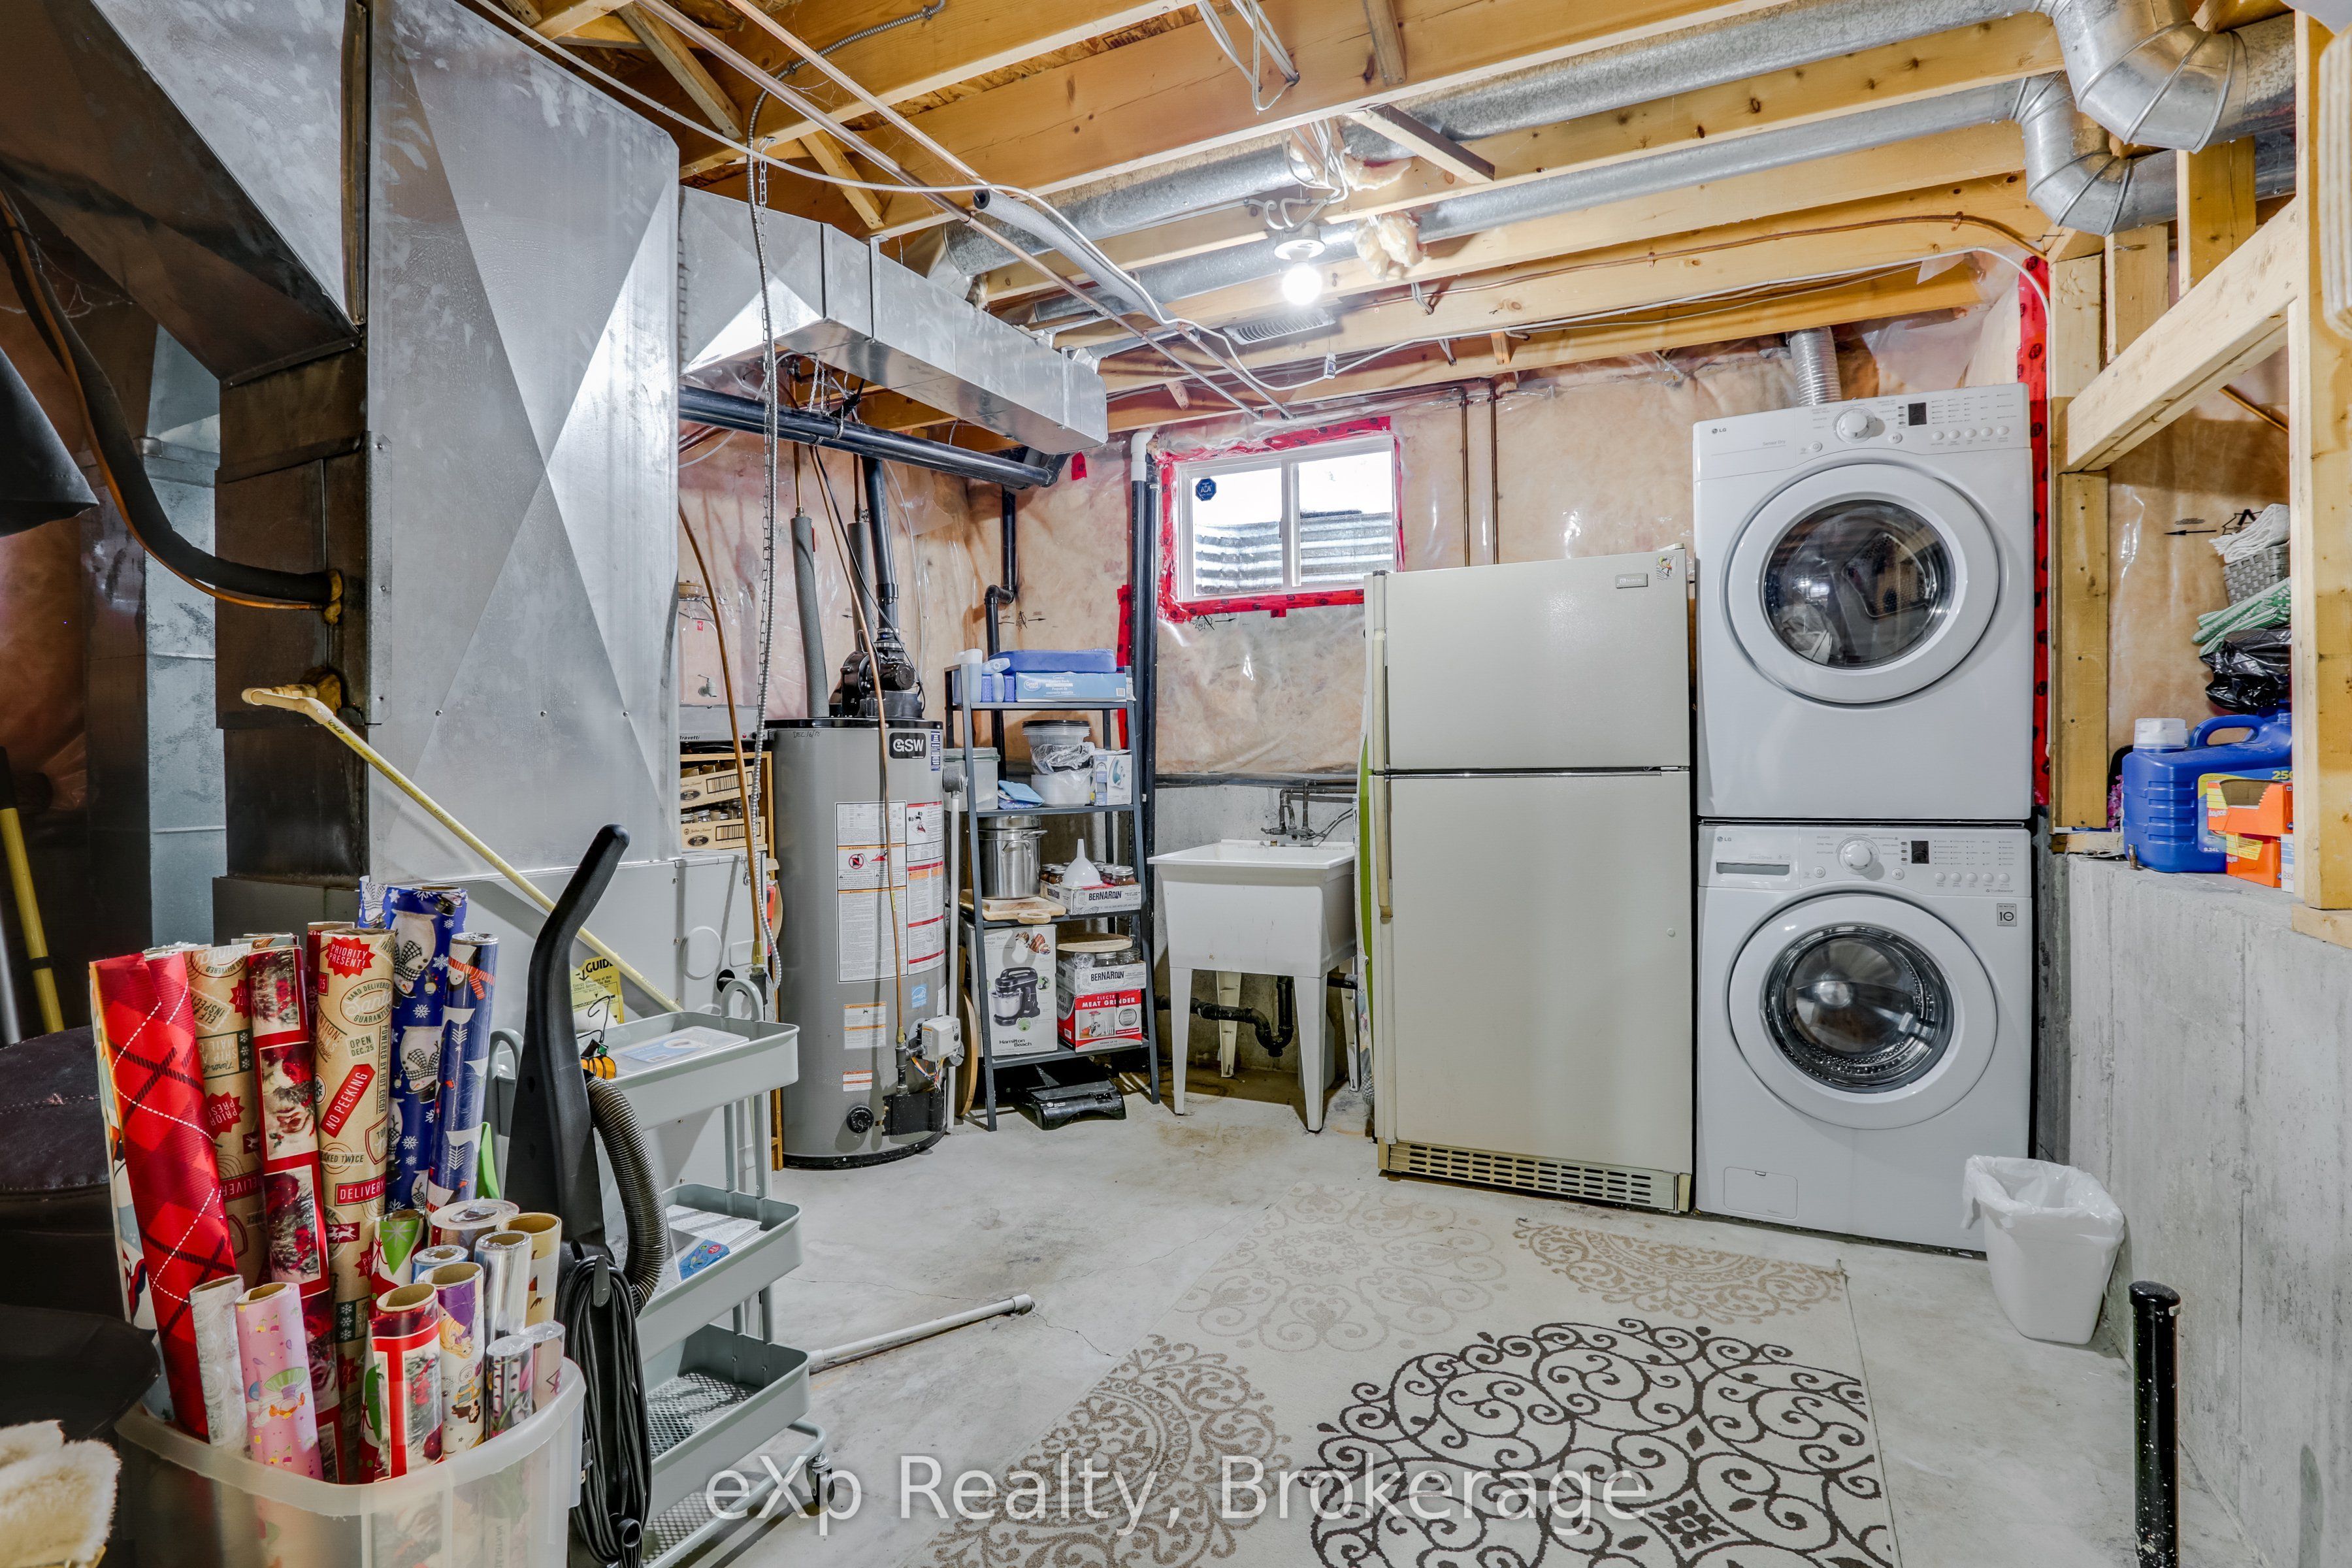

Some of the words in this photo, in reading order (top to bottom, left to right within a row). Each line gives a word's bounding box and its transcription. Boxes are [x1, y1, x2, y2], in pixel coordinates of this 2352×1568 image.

[892, 738, 924, 752] GSW
[1088, 890, 1122, 901] BERNARDIN
[331, 944, 368, 960] PRIORITY
[329, 953, 366, 968] PRESENT!
[585, 958, 614, 973] GUID
[1090, 971, 1124, 981] BERNARDIN
[347, 988, 362, 1001] HAND
[363, 982, 390, 992] DELIVERED
[353, 1004, 391, 1023] GUARANTEED
[212, 1037, 235, 1051] MAIL
[350, 1036, 371, 1049] OPEN
[214, 1048, 237, 1062] SHIP
[351, 1045, 374, 1056] DEC.25
[380, 1061, 386, 1070] BY
[325, 1115, 341, 1130] NO
[334, 1072, 368, 1115] PEEKING
[342, 1154, 364, 1163] TWICE
